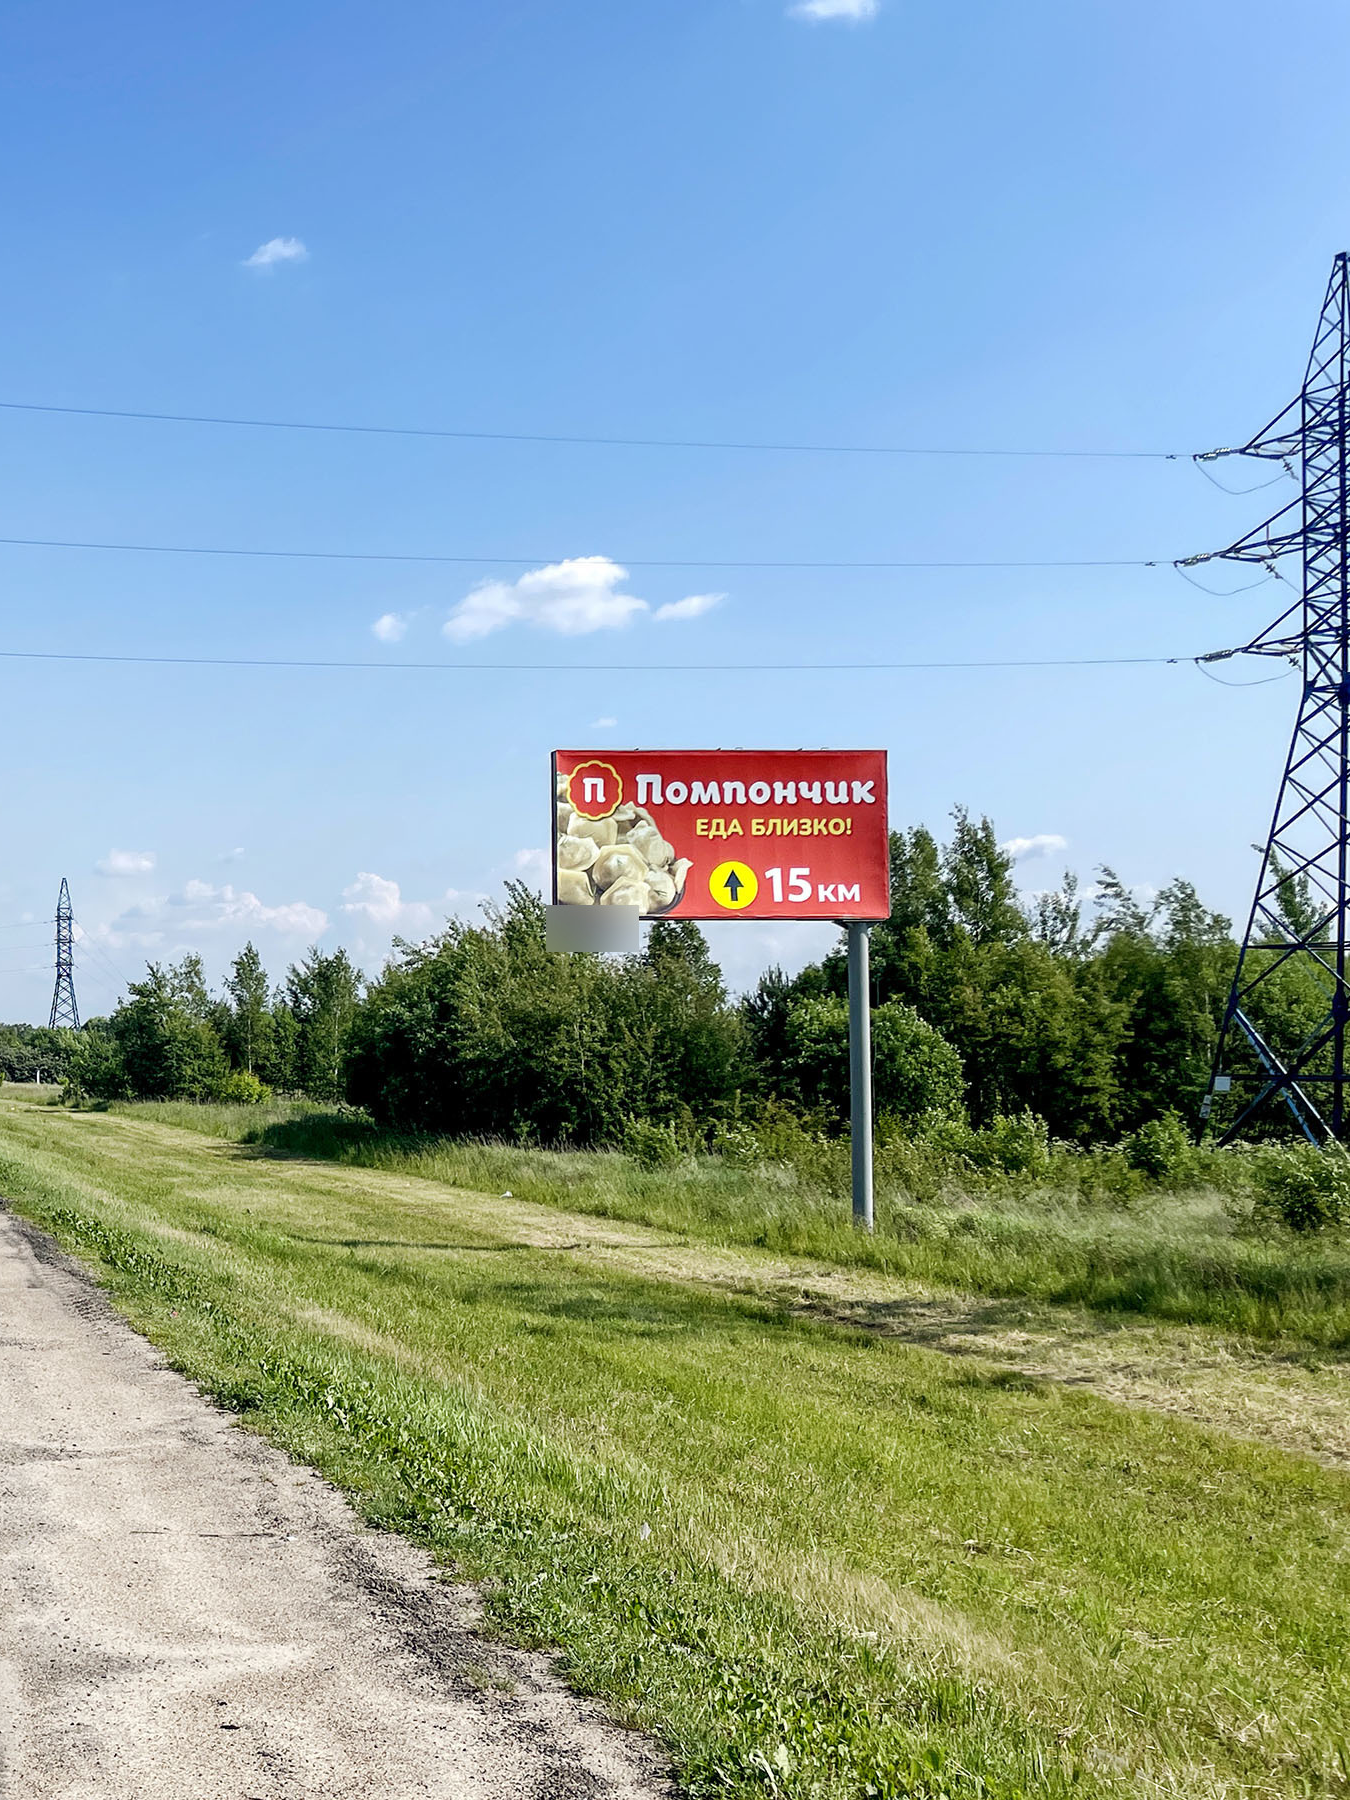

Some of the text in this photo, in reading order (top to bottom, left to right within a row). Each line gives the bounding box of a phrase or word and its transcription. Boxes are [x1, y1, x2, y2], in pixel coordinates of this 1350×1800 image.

[636, 773, 876, 805] Помпончик
[696, 818, 853, 839] ЕДА БЛИЗКО!
[765, 867, 812, 903] 15
